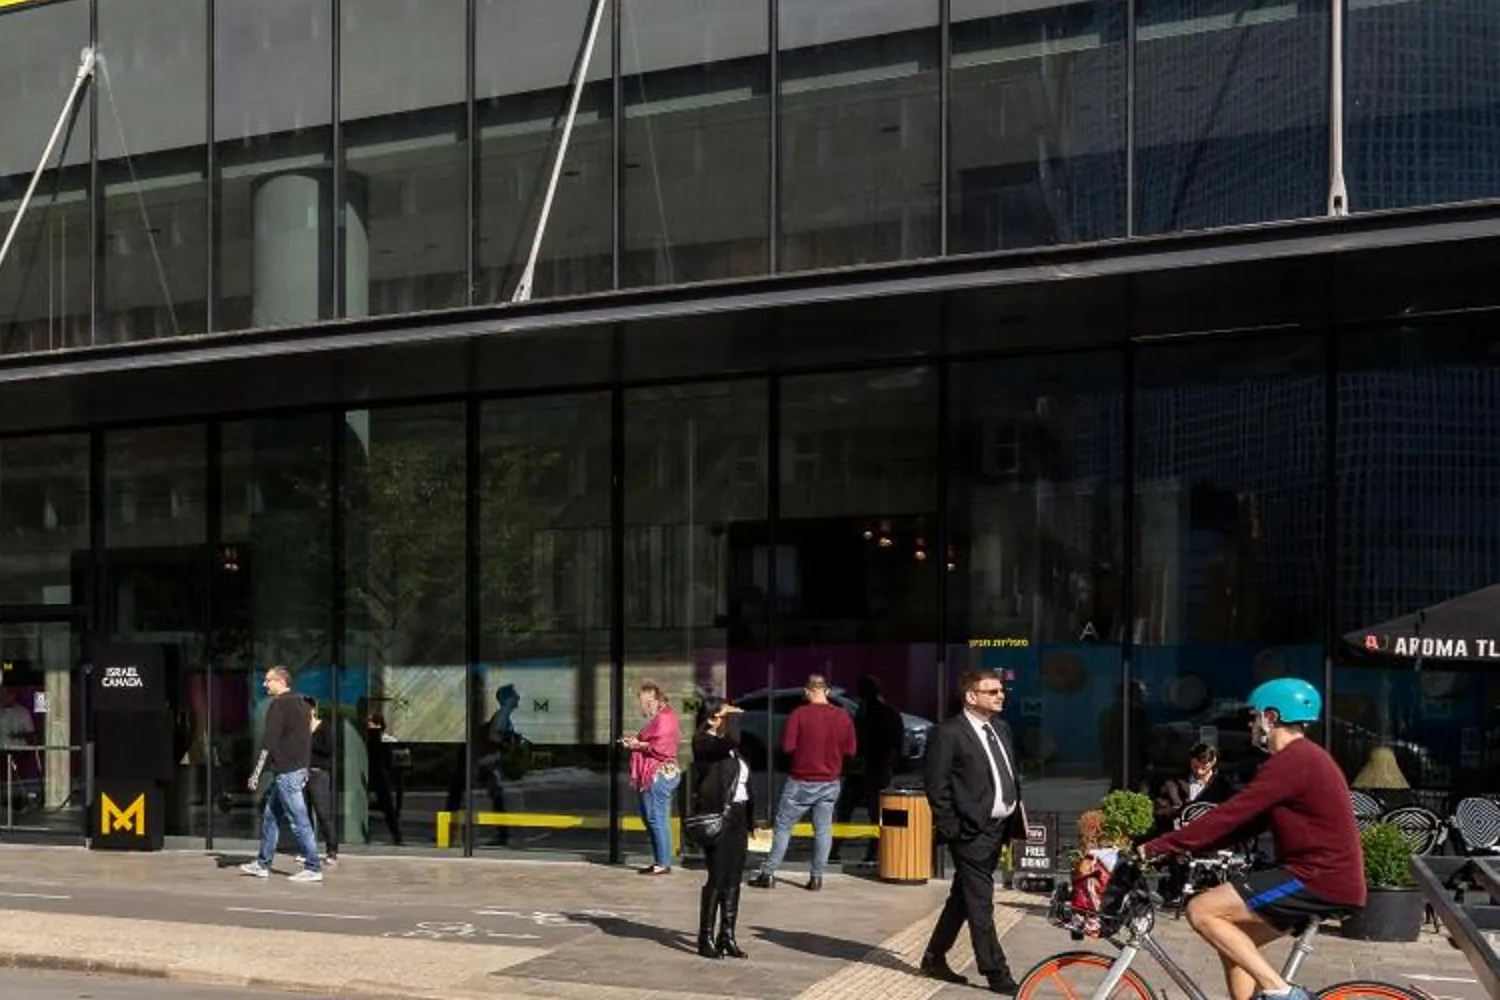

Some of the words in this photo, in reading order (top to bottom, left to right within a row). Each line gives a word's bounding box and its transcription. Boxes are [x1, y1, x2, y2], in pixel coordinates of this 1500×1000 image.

[1395, 637, 1468, 657] AROMA
[533, 699, 549, 712] M
[101, 791, 145, 835] M
